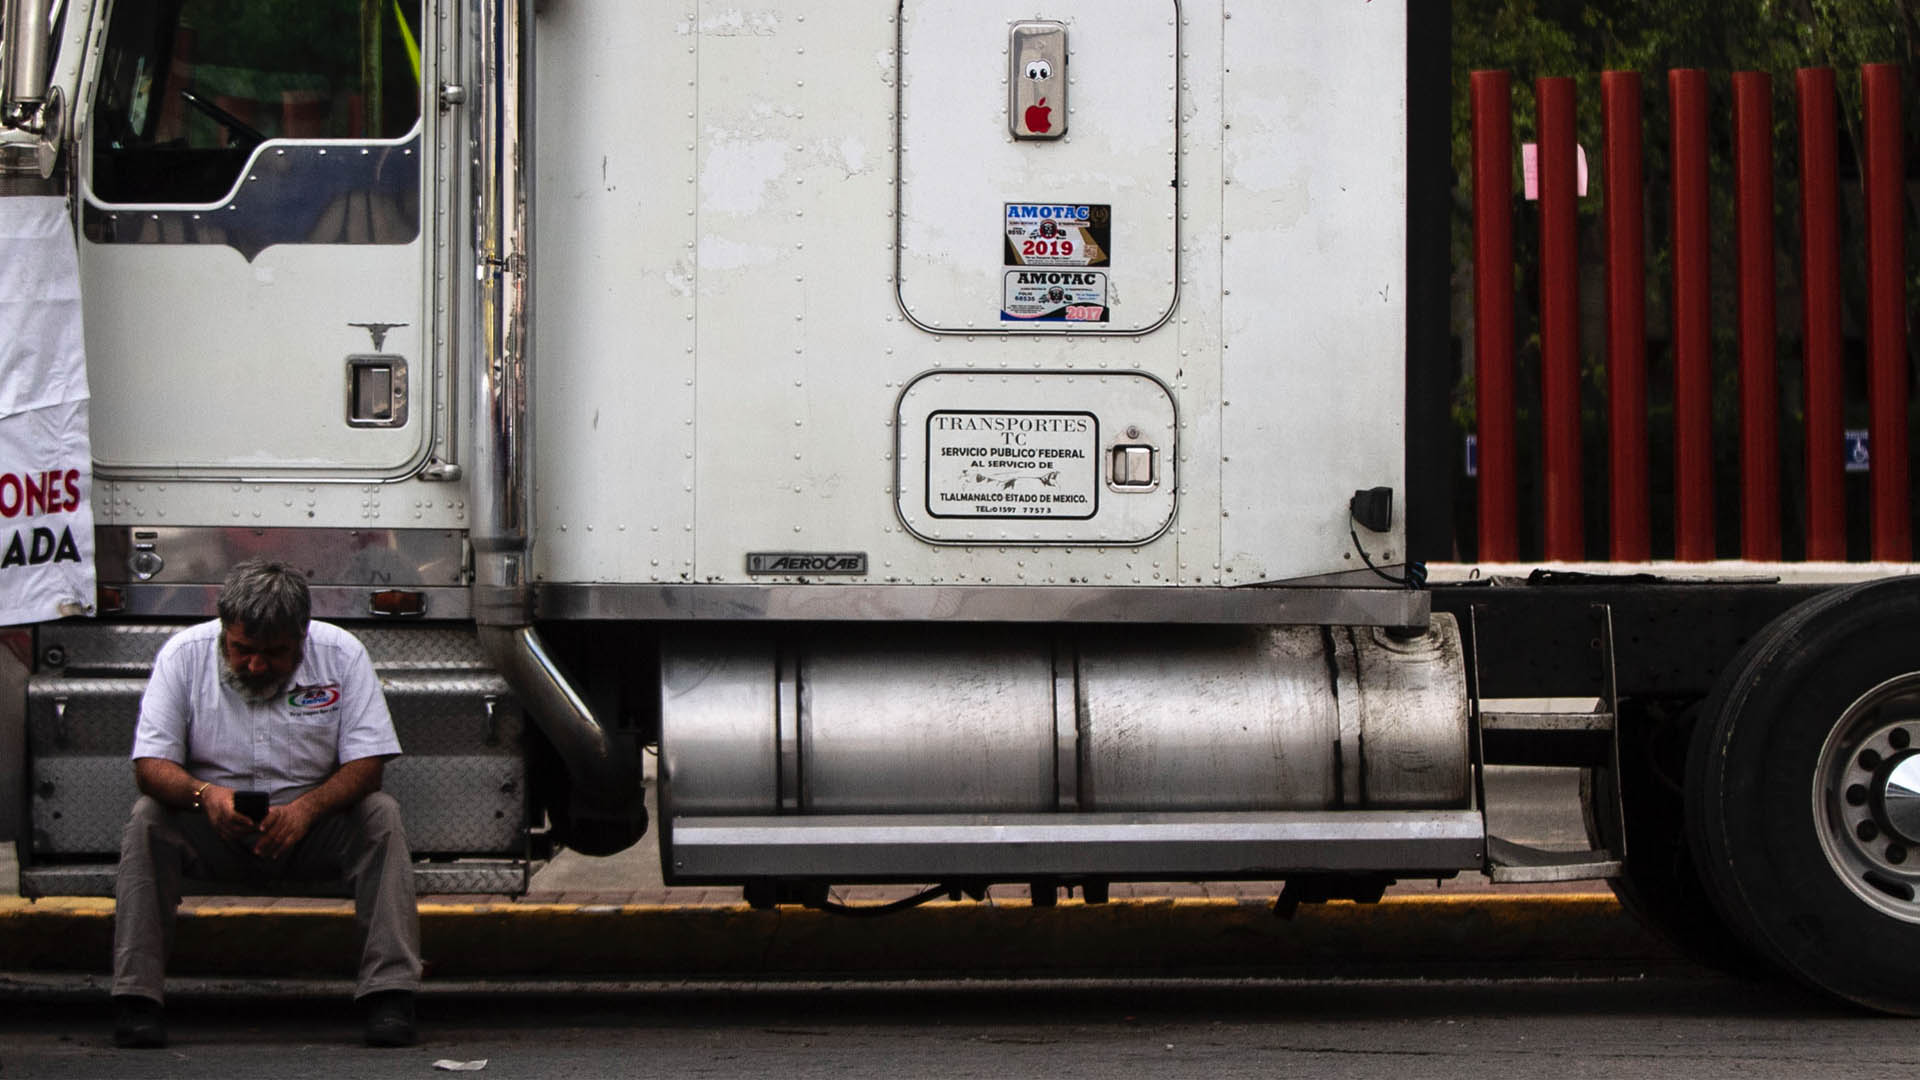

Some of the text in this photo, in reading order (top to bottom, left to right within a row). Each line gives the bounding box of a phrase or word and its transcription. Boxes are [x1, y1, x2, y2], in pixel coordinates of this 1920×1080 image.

[1008, 206, 1089, 219] AMOTAC
[1022, 240, 1073, 256] 2019
[1017, 273, 1096, 285] AMOTAC
[1066, 306, 1103, 321] 2017
[936, 417, 1087, 432] TRANSPORTES
[1001, 432, 1026, 446] TC
[941, 447, 1085, 459] SERVICIO PUBLICO FEDERAL
[970, 460, 1053, 469] AL SERVICIO DE
[0, 469, 81, 518] ONES
[940, 492, 1088, 504] TLALMANALCO ESTADO DE MEXICO.
[1, 525, 82, 569] ADA
